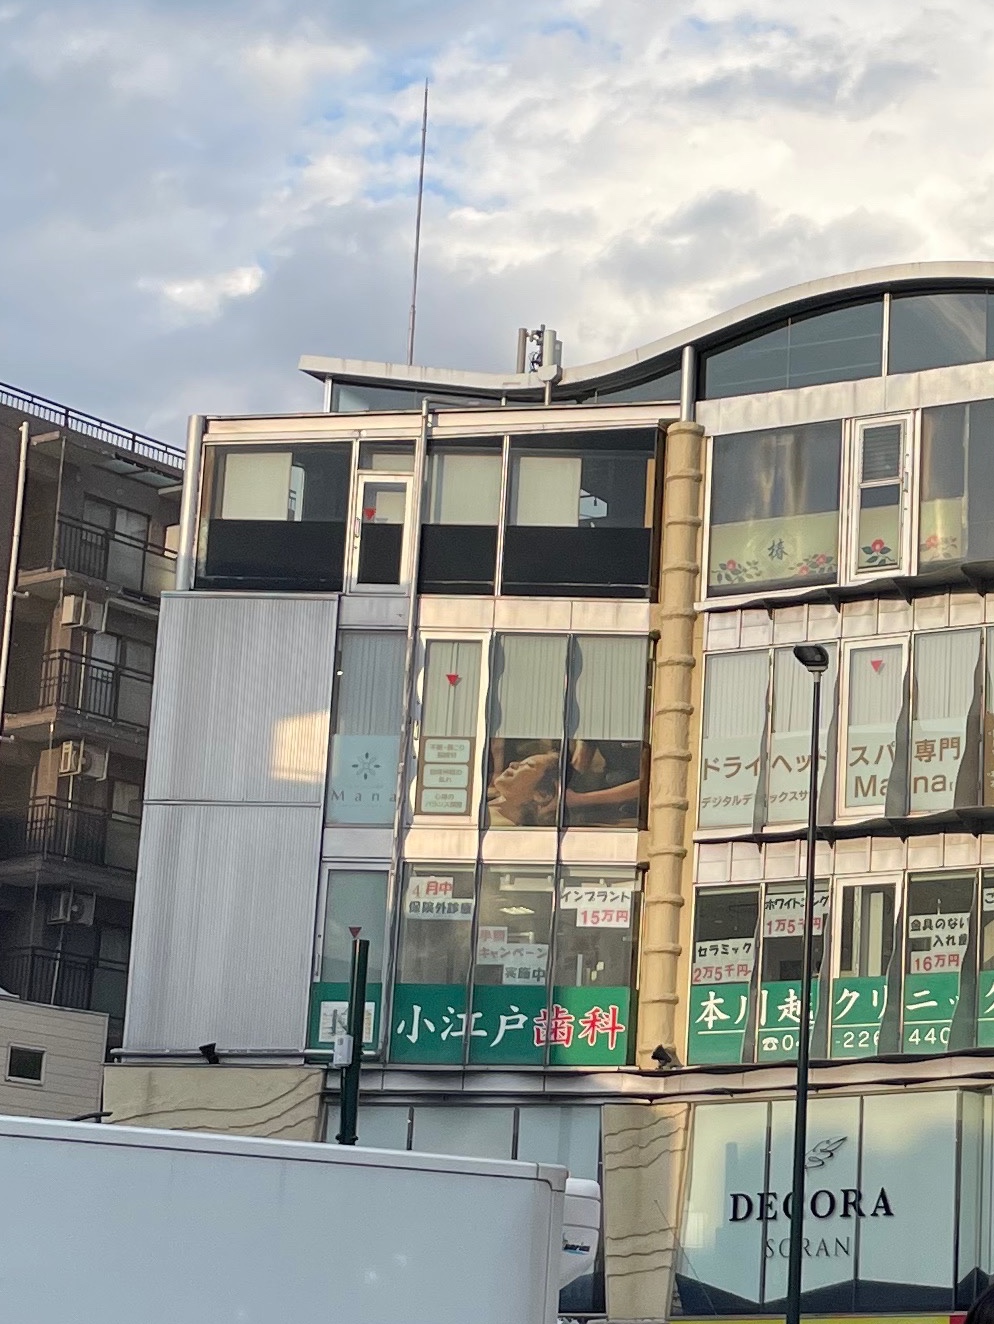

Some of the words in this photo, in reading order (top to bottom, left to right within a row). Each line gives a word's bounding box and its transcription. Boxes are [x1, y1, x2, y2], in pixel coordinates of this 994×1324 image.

[766, 537, 790, 561] 椿
[560, 890, 631, 904] インプラント
[580, 909, 630, 926] 15万円
[480, 947, 548, 959] キャンペーン
[697, 941, 752, 958] セラミック
[914, 953, 961, 972] 16万円
[693, 963, 752, 984] 2万5千円
[396, 1003, 626, 1051] 小江戸歯科
